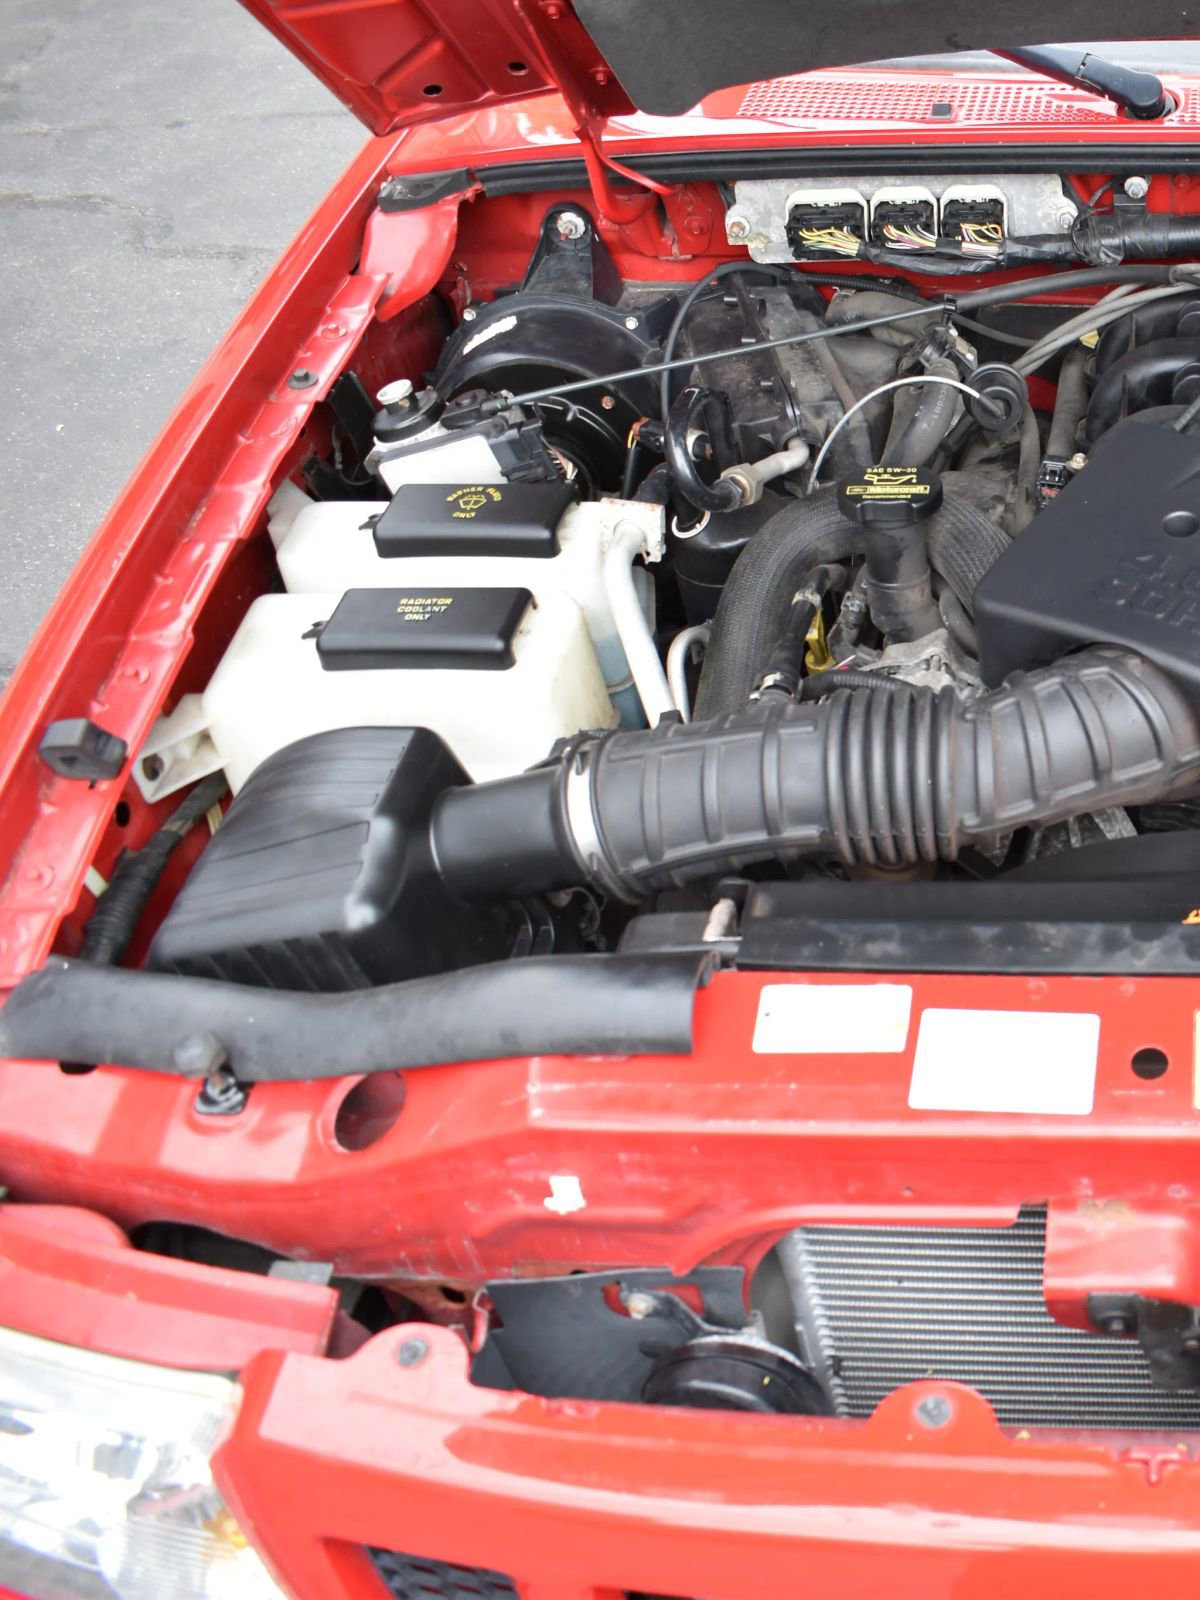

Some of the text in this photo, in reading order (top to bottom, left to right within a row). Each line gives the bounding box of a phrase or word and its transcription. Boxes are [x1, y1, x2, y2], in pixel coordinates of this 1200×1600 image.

[446, 486, 484, 502] WASHER
[400, 597, 453, 605] RADIATOR
[404, 613, 431, 621] ONLY
